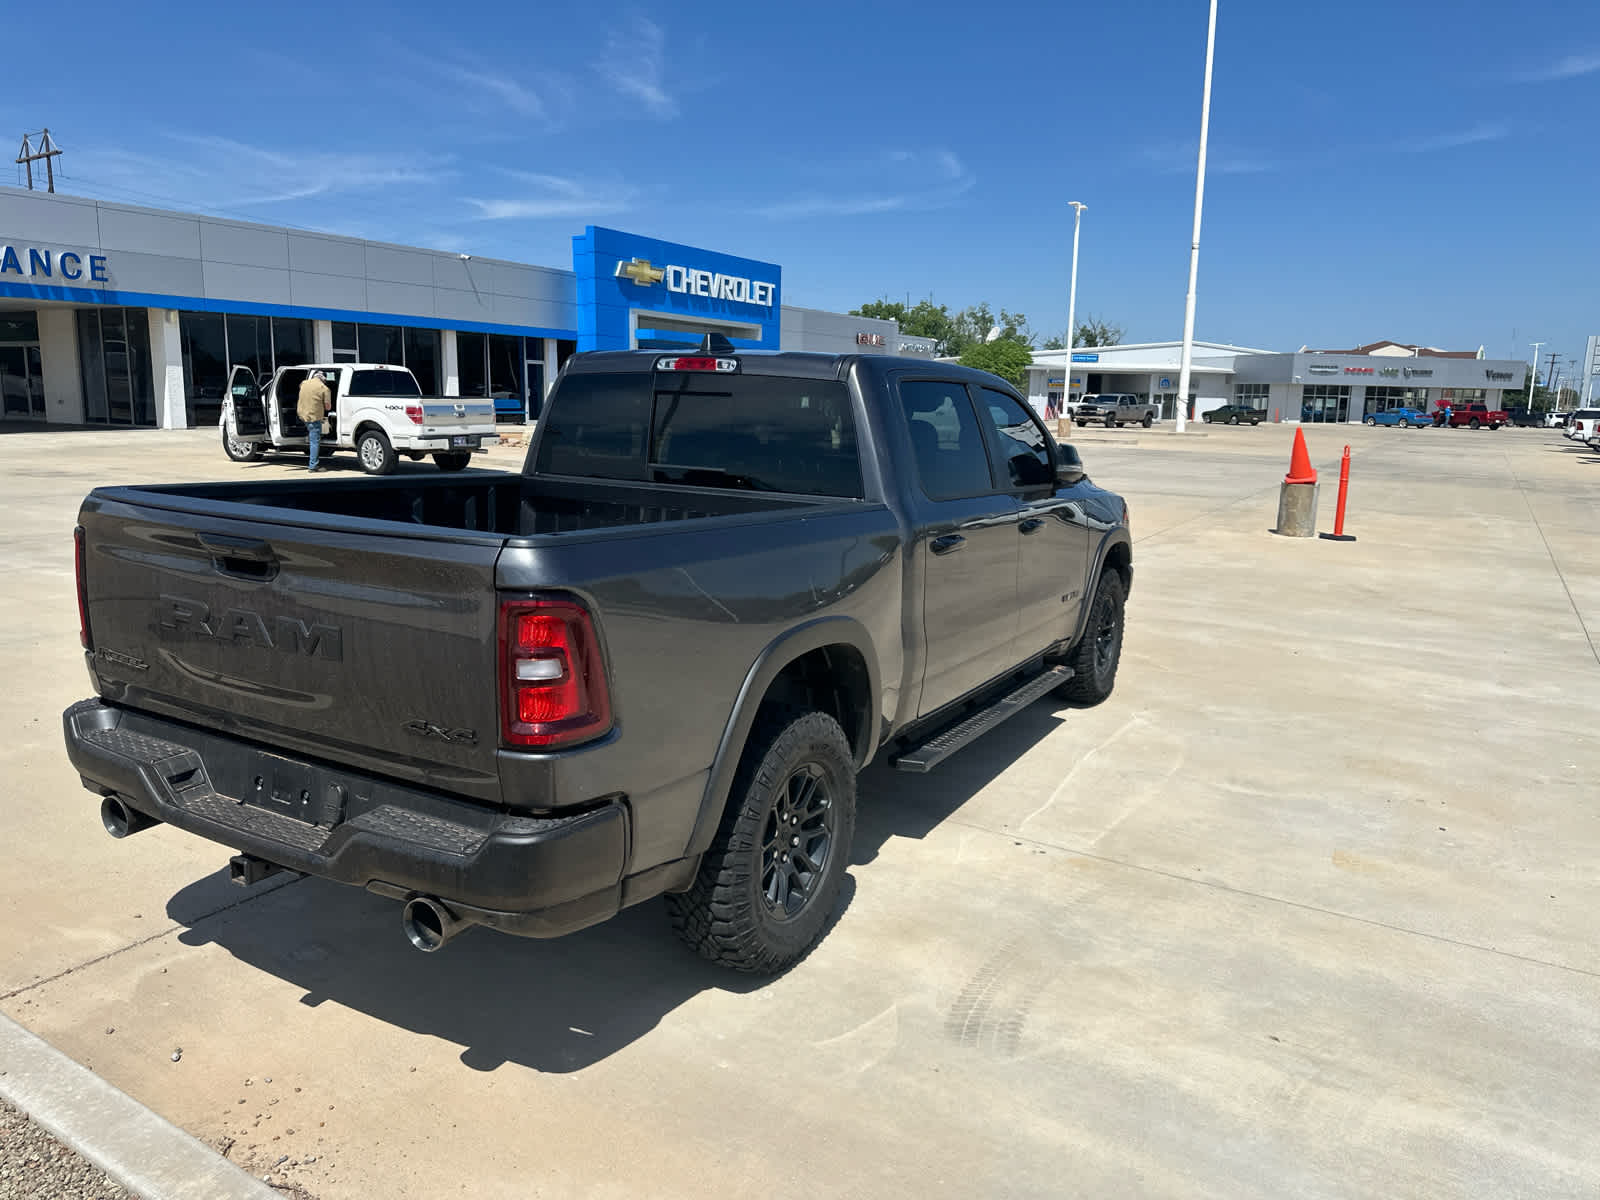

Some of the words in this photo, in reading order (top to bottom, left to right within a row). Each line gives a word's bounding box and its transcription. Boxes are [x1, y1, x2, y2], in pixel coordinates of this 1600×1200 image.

[0, 245, 109, 282] ANCE
[666, 264, 776, 307] CHEVROLET
[159, 593, 343, 664] RAM
